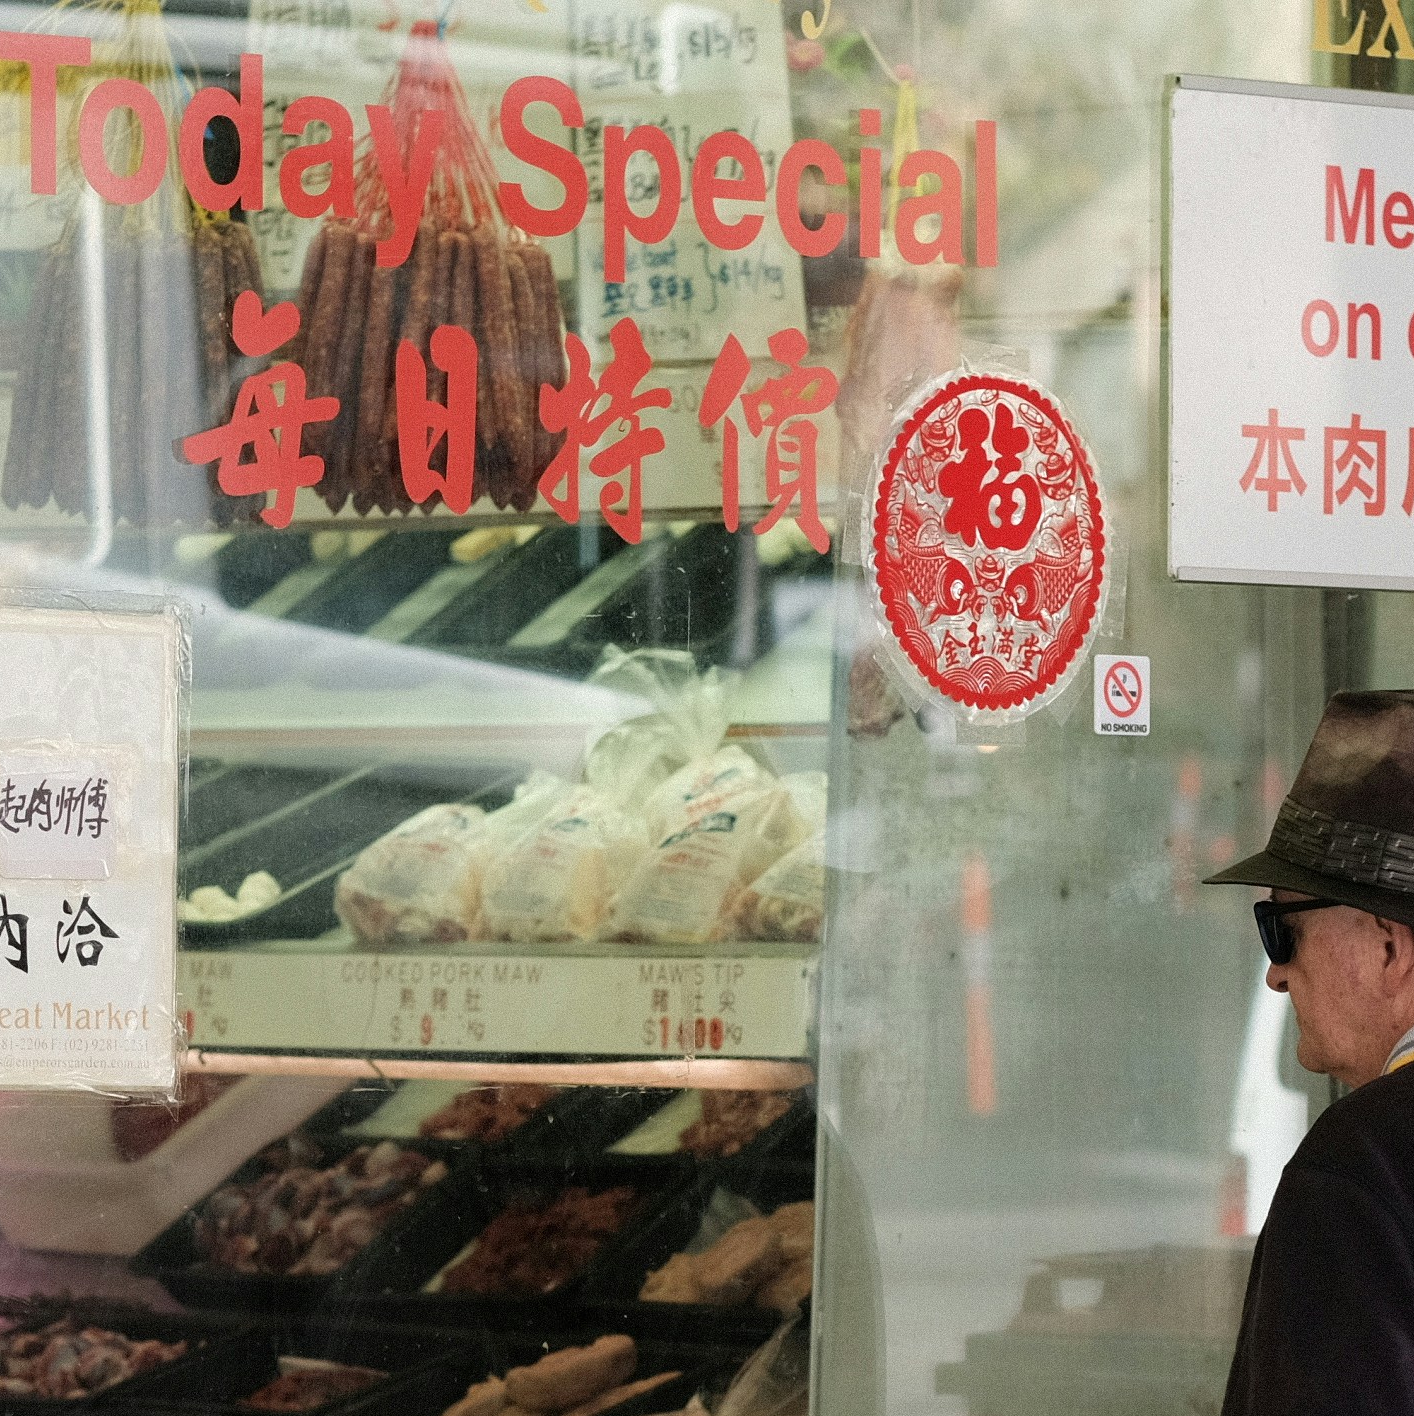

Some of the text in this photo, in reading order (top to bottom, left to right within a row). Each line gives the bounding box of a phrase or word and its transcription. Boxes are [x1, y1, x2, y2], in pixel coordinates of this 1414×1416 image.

[499, 76, 997, 283] Special
[1300, 298, 1381, 361] on
[174, 290, 840, 554] 每日特價
[1101, 723, 1148, 734] NO SMOKING
[340, 961, 543, 985] COOKED PORK MAW
[714, 963, 745, 984] TIP
[52, 1002, 150, 1031] Market
